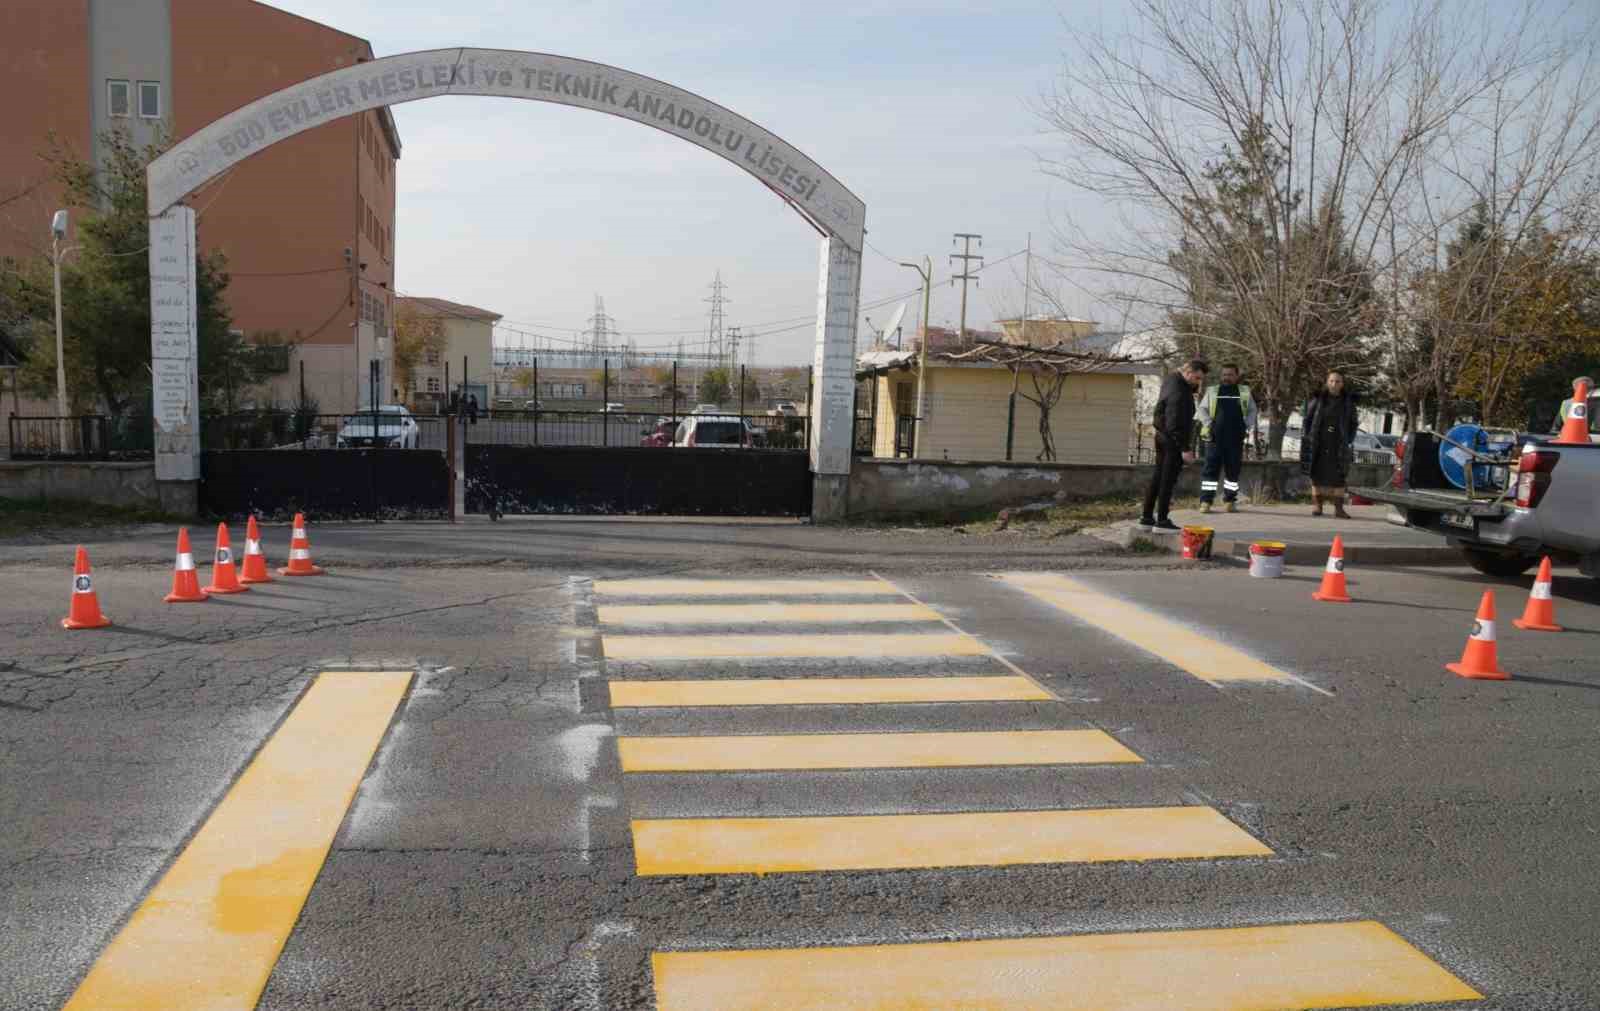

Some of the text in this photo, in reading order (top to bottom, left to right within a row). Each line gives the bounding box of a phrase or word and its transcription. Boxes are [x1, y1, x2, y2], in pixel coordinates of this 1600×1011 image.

[217, 63, 822, 201] 500 EVLER MESLEKİ ve TEKNİK ANADOLU LİSESİ
